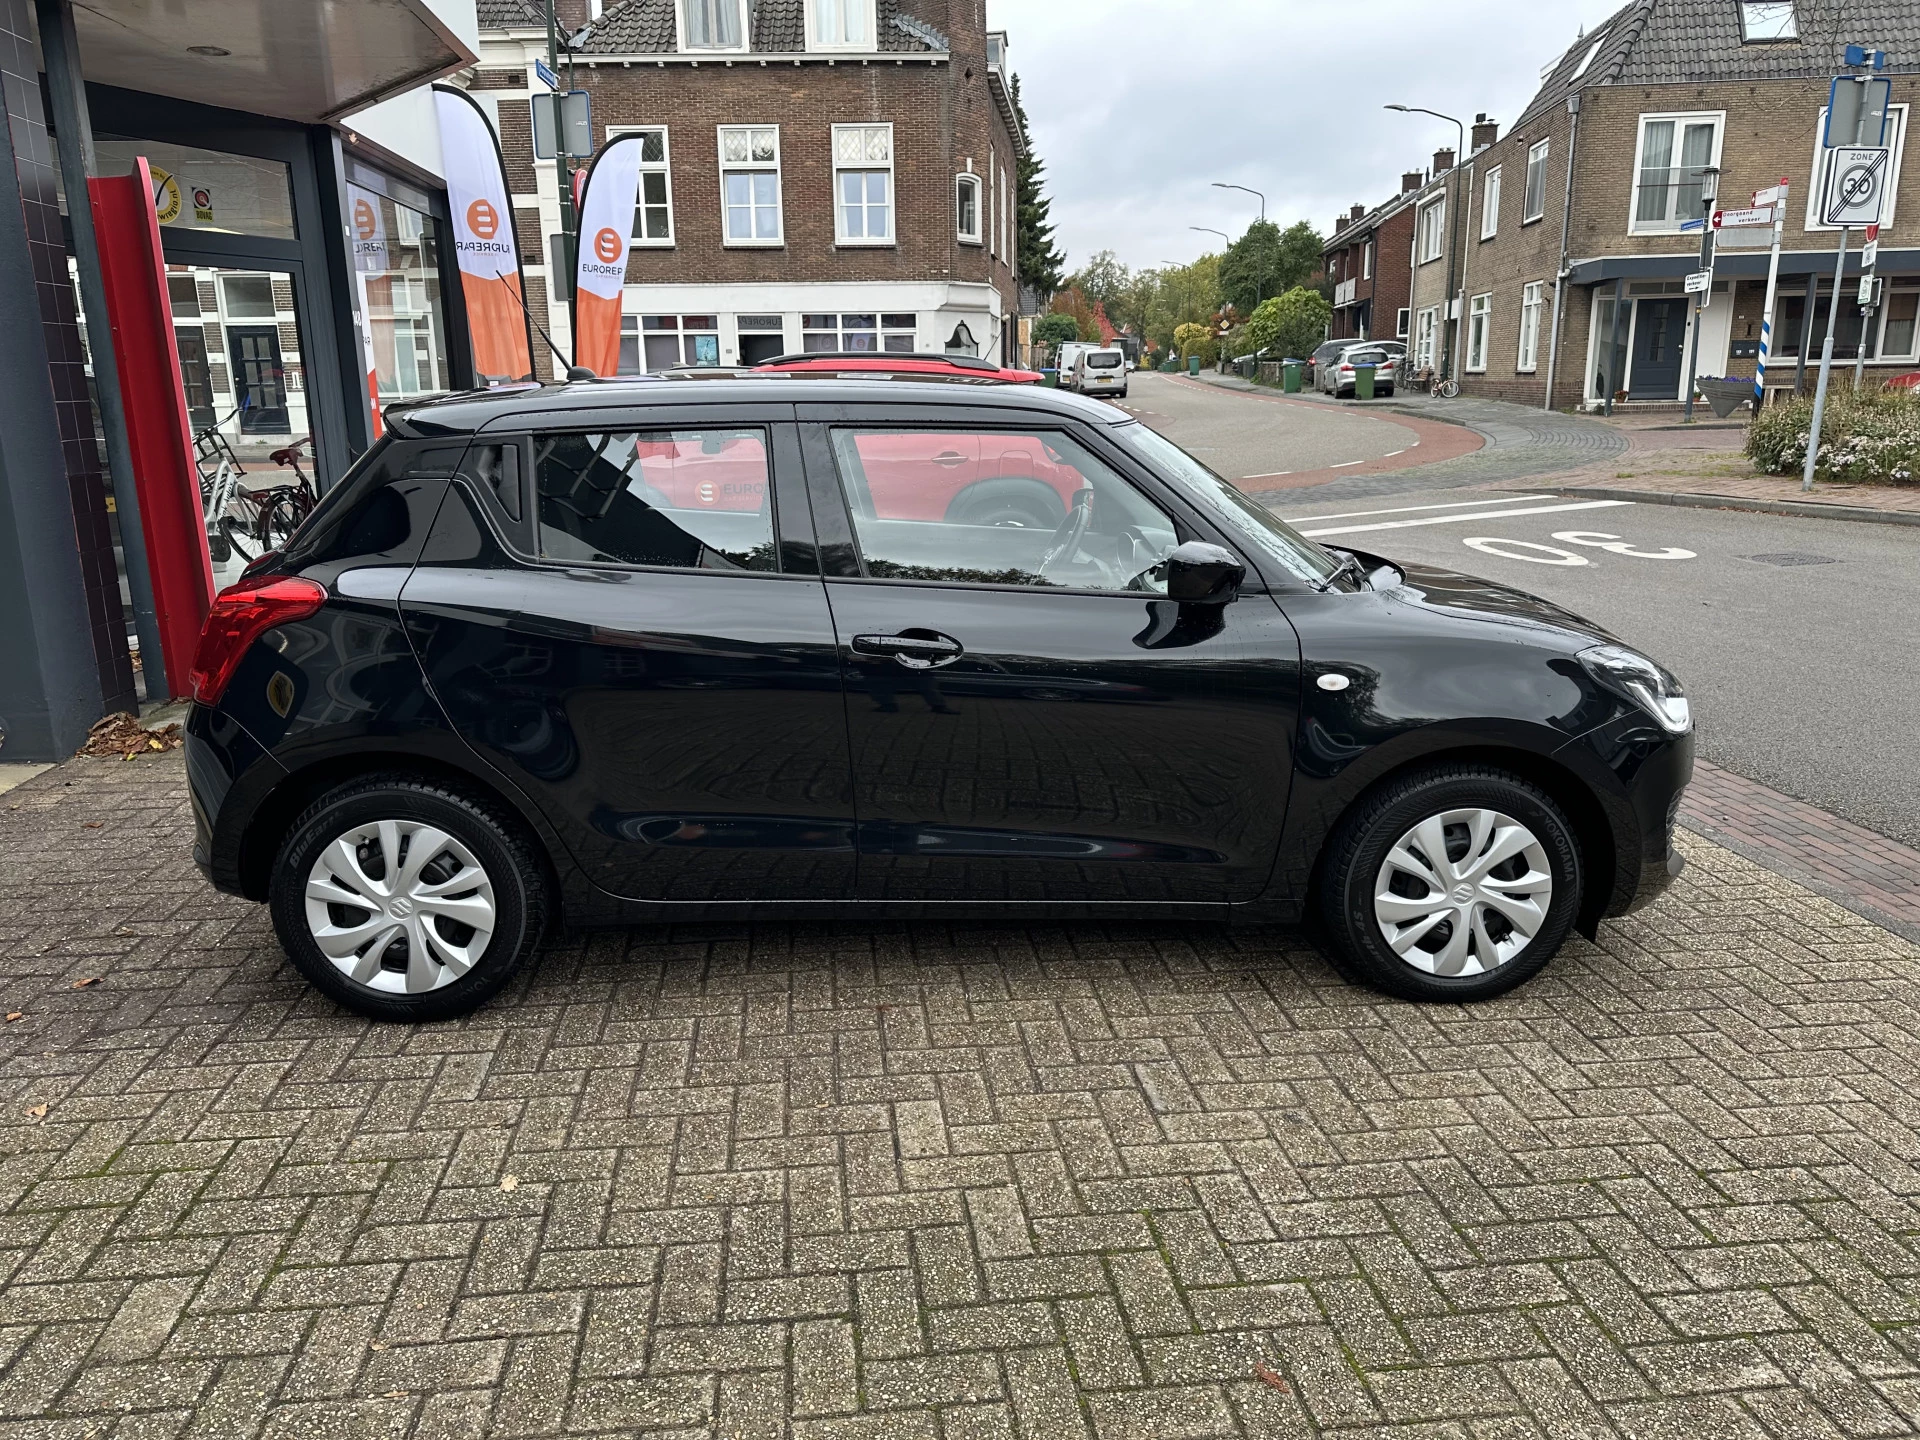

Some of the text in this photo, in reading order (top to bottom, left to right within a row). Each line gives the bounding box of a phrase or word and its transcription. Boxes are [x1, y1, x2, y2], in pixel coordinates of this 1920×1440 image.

[1850, 152, 1874, 161] ZONE
[1844, 177, 1872, 196] 30
[195, 210, 213, 220] BOVAG
[1463, 531, 1697, 566] 30
[1543, 815, 1576, 882] YOKOHAMA
